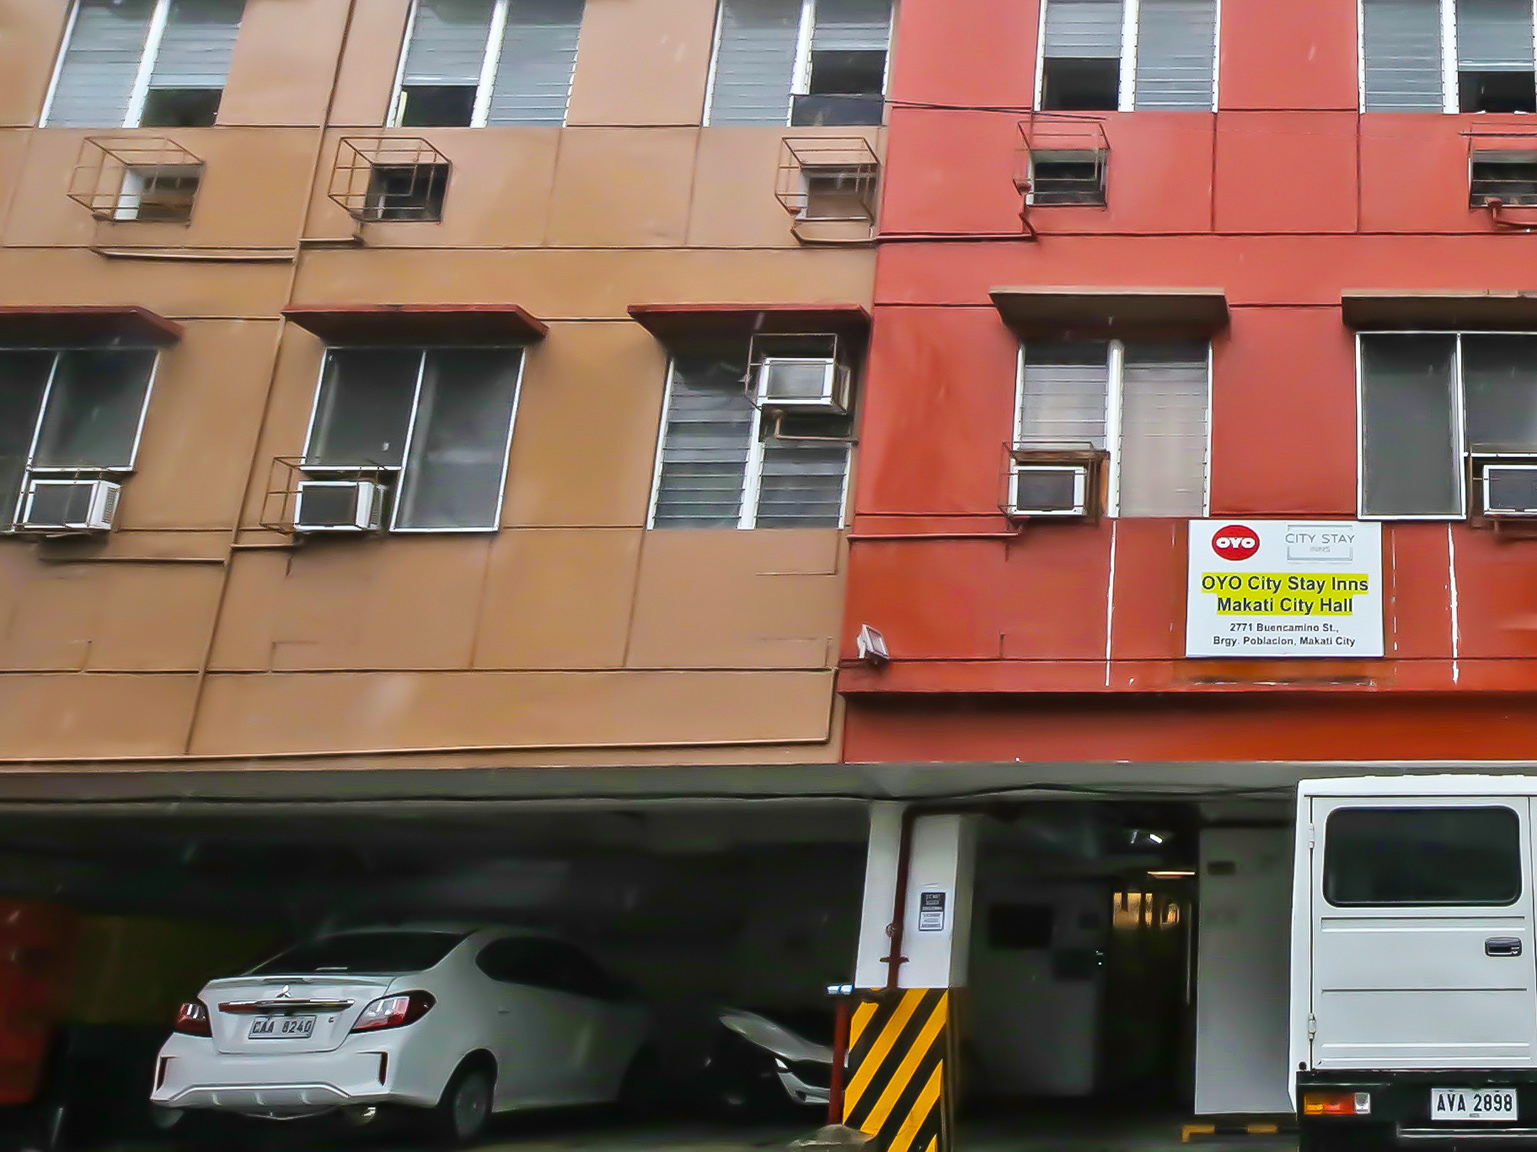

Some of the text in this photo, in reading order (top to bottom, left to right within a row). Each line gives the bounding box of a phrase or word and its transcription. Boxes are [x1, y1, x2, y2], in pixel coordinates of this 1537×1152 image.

[1215, 536, 1256, 549] OYO
[1285, 533, 1355, 544] CITY STAY
[1201, 575, 1369, 595] OYO City Stay Inns
[1217, 597, 1353, 615] Makati City Hall
[1229, 623, 1253, 632] 2771
[1256, 623, 1320, 632] Buencamino
[1213, 636, 1240, 647] Brgy.
[1299, 636, 1333, 645] Makati
[1335, 636, 1356, 647] City
[1437, 1093, 1513, 1112] AVA 2898
